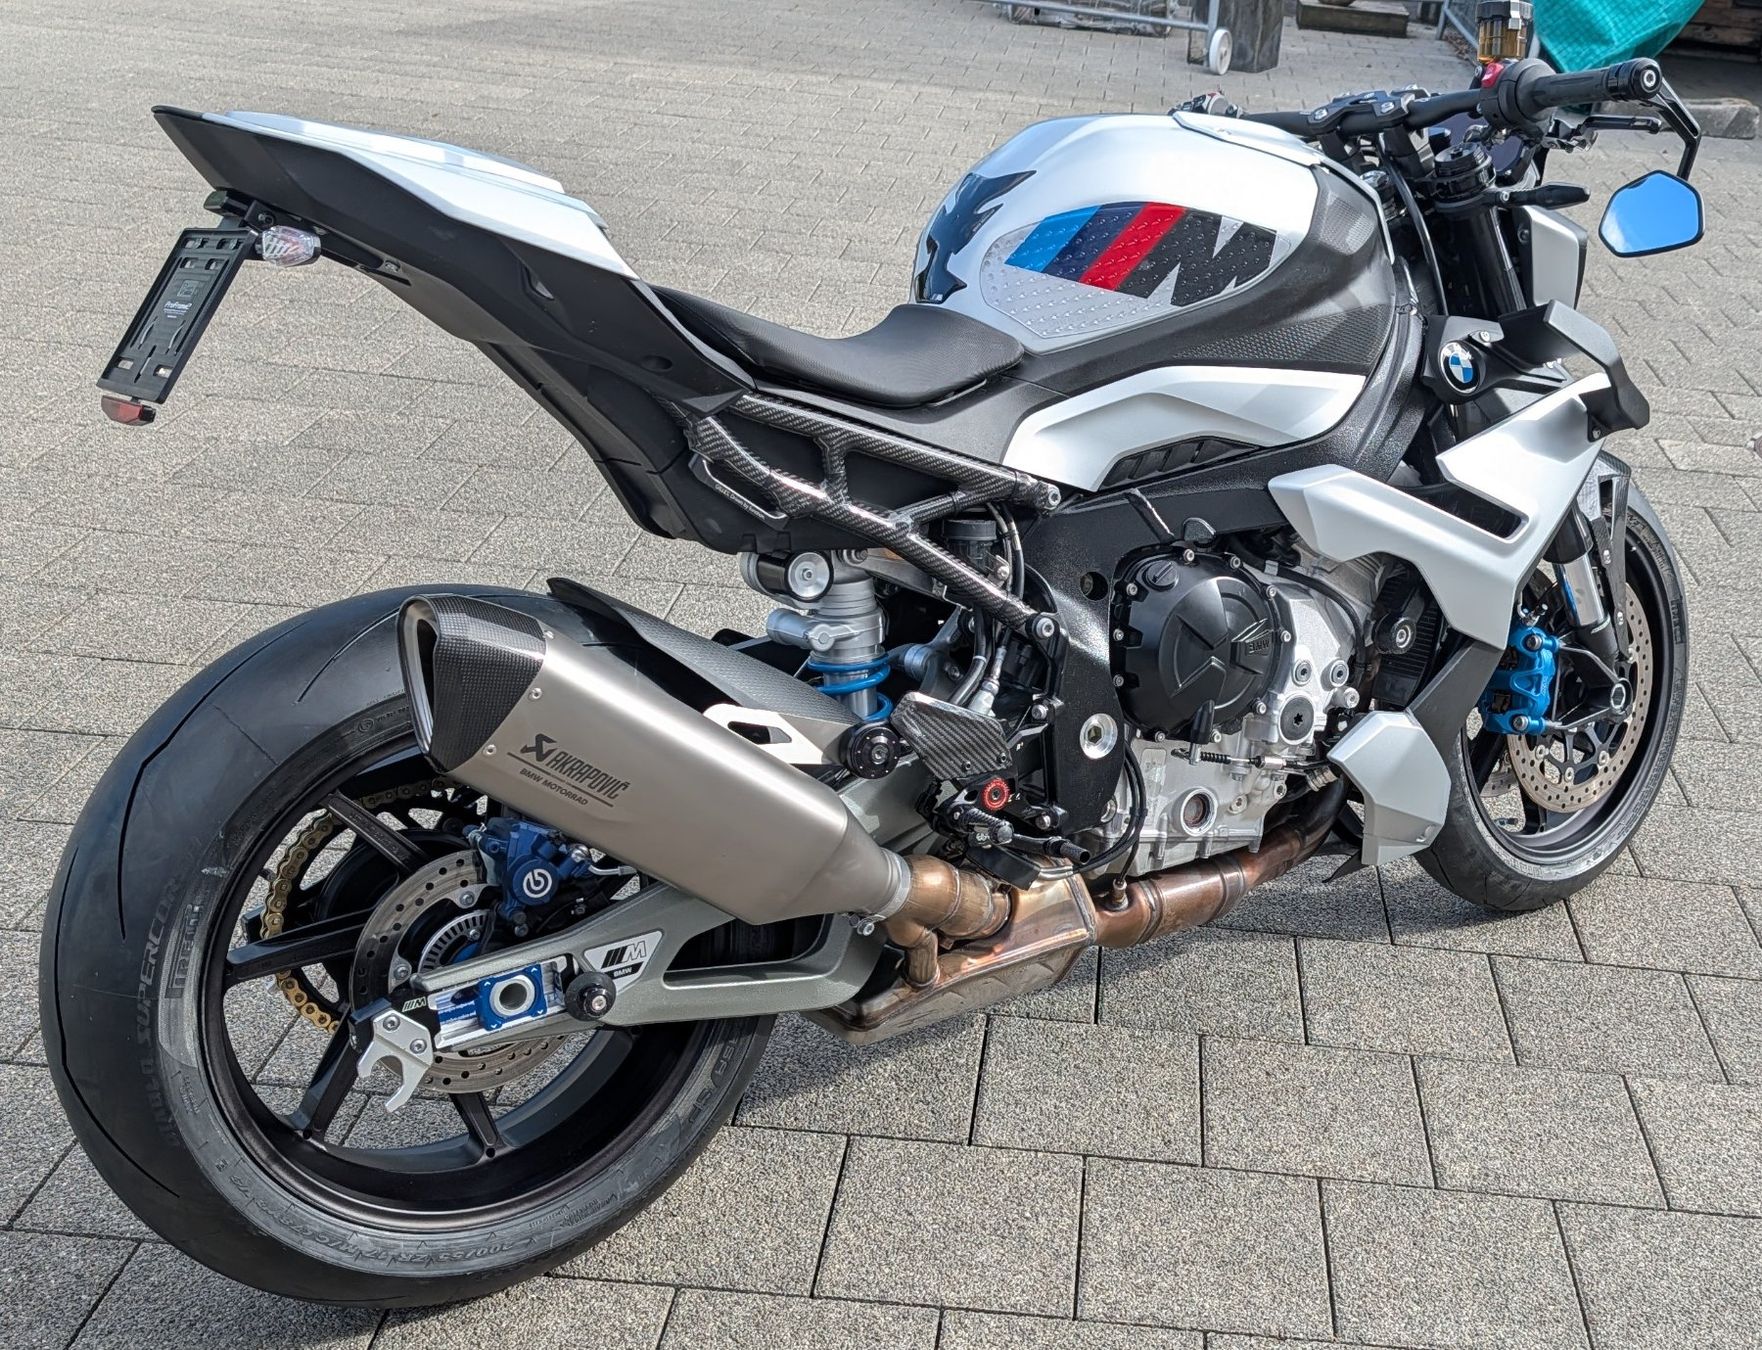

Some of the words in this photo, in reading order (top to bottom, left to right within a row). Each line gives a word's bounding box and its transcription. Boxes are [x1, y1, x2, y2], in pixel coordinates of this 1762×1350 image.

[520, 768, 543, 783] BMW
[541, 780, 589, 806] MOTORRAD
[613, 966, 632, 978] BMW
